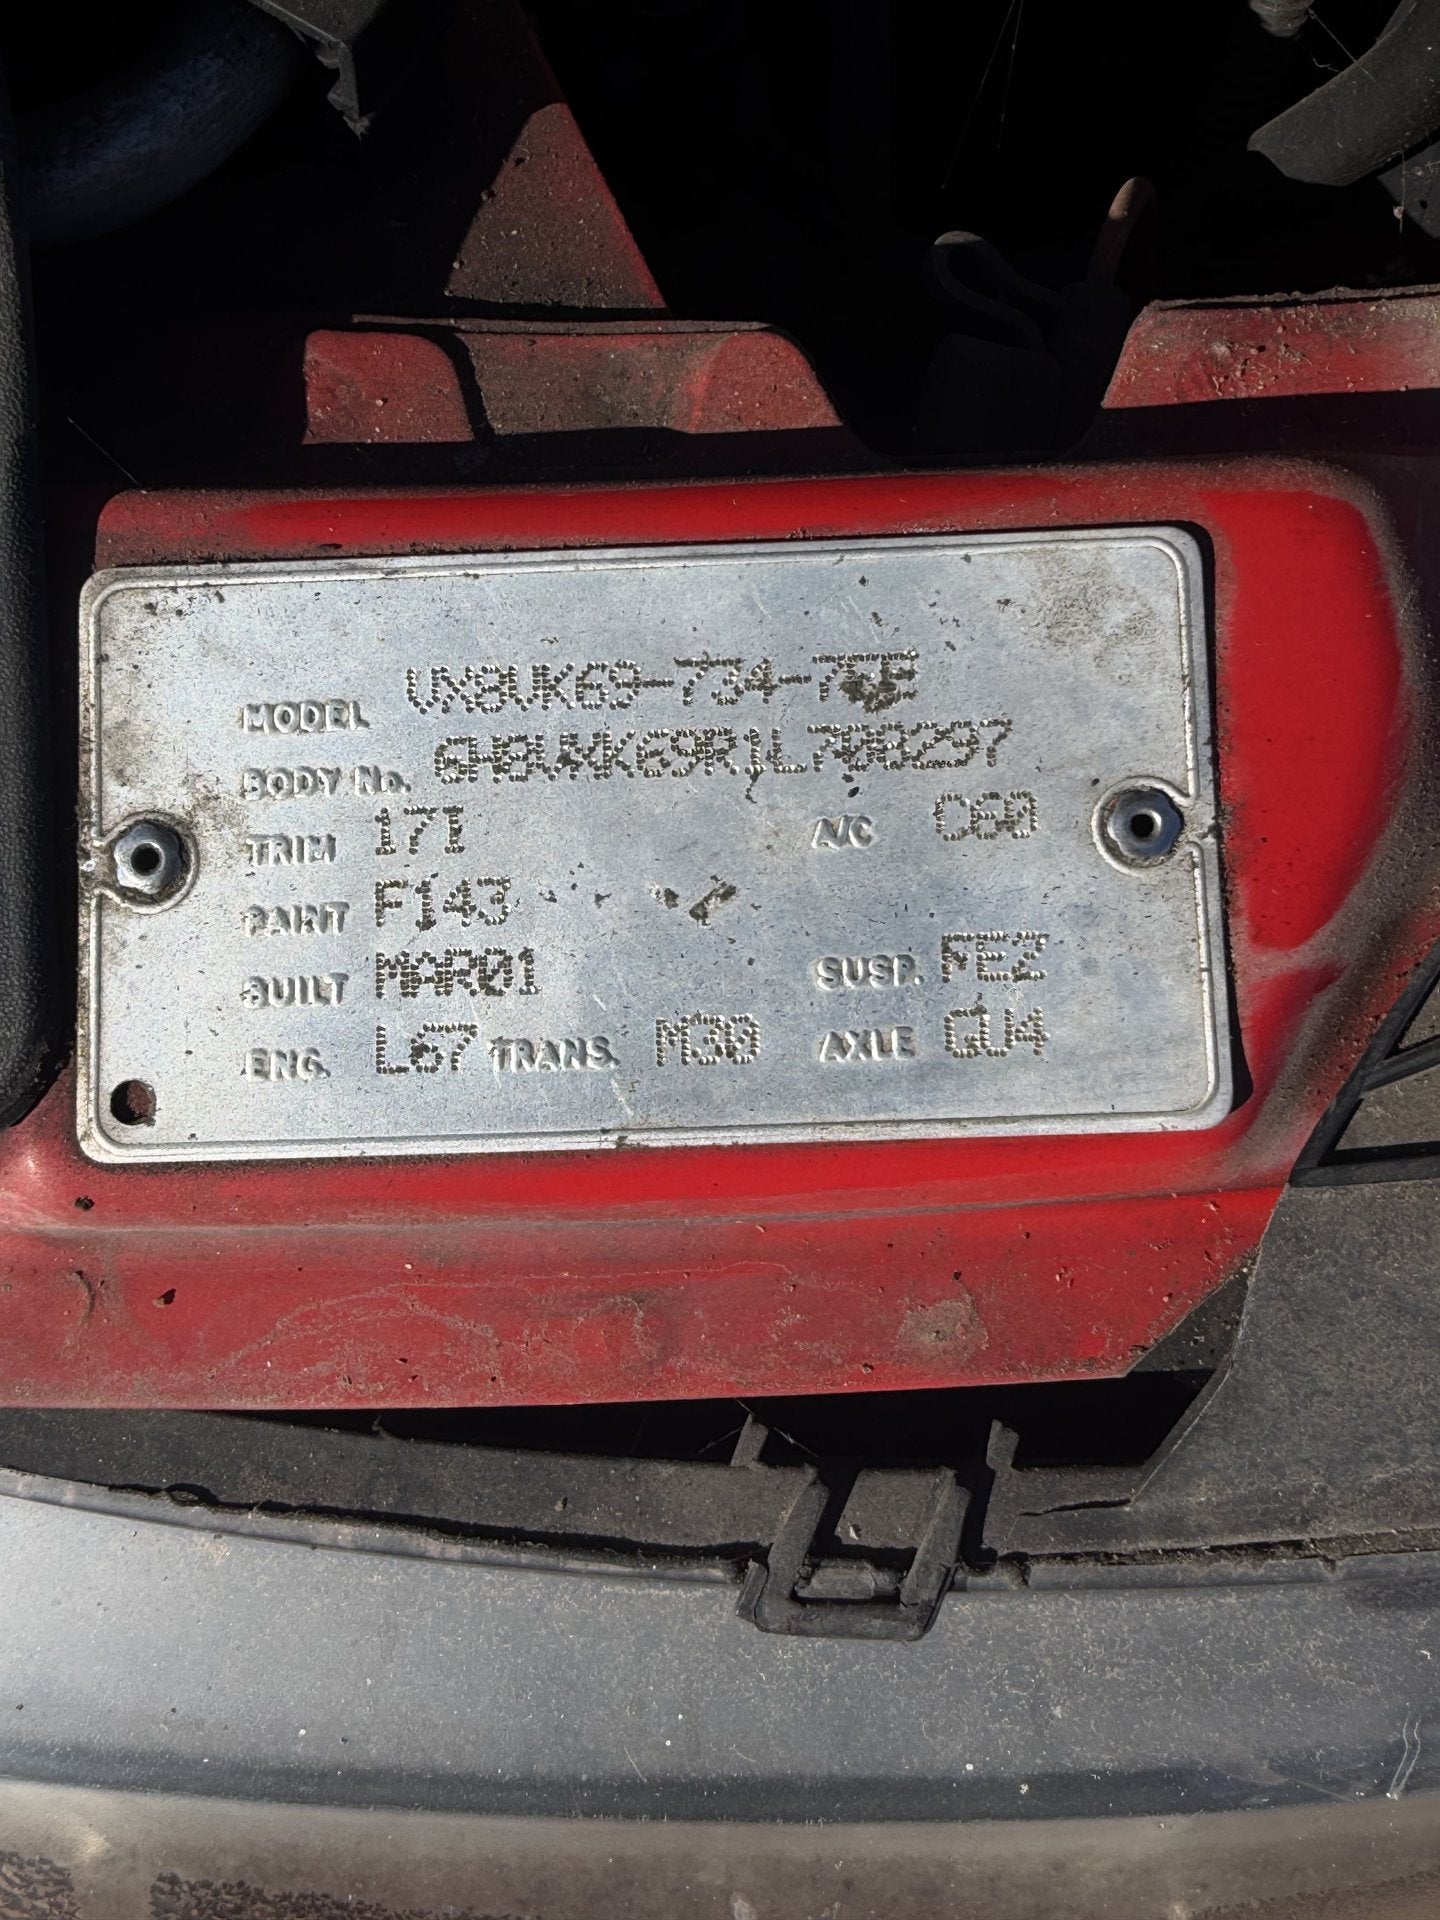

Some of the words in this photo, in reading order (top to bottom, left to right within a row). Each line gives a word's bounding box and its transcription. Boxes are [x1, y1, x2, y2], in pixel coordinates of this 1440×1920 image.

[242, 699, 370, 734] MODEL
[242, 766, 342, 800] BODY
[354, 766, 411, 796] No.
[246, 833, 337, 867] TRIM
[811, 814, 875, 851] A/C
[933, 790, 1038, 842] C60
[243, 901, 350, 936] PAINT
[374, 876, 512, 932] F143
[241, 972, 349, 1008] BUILT
[374, 947, 539, 999] MAR01
[814, 953, 924, 991] SUSP.
[941, 930, 1049, 984] FE2
[243, 1047, 332, 1081] ENG.
[375, 1021, 478, 1075] L67
[485, 1036, 621, 1073] TRANS.
[656, 1012, 760, 1067] M30
[818, 1024, 918, 1063] AXLE
